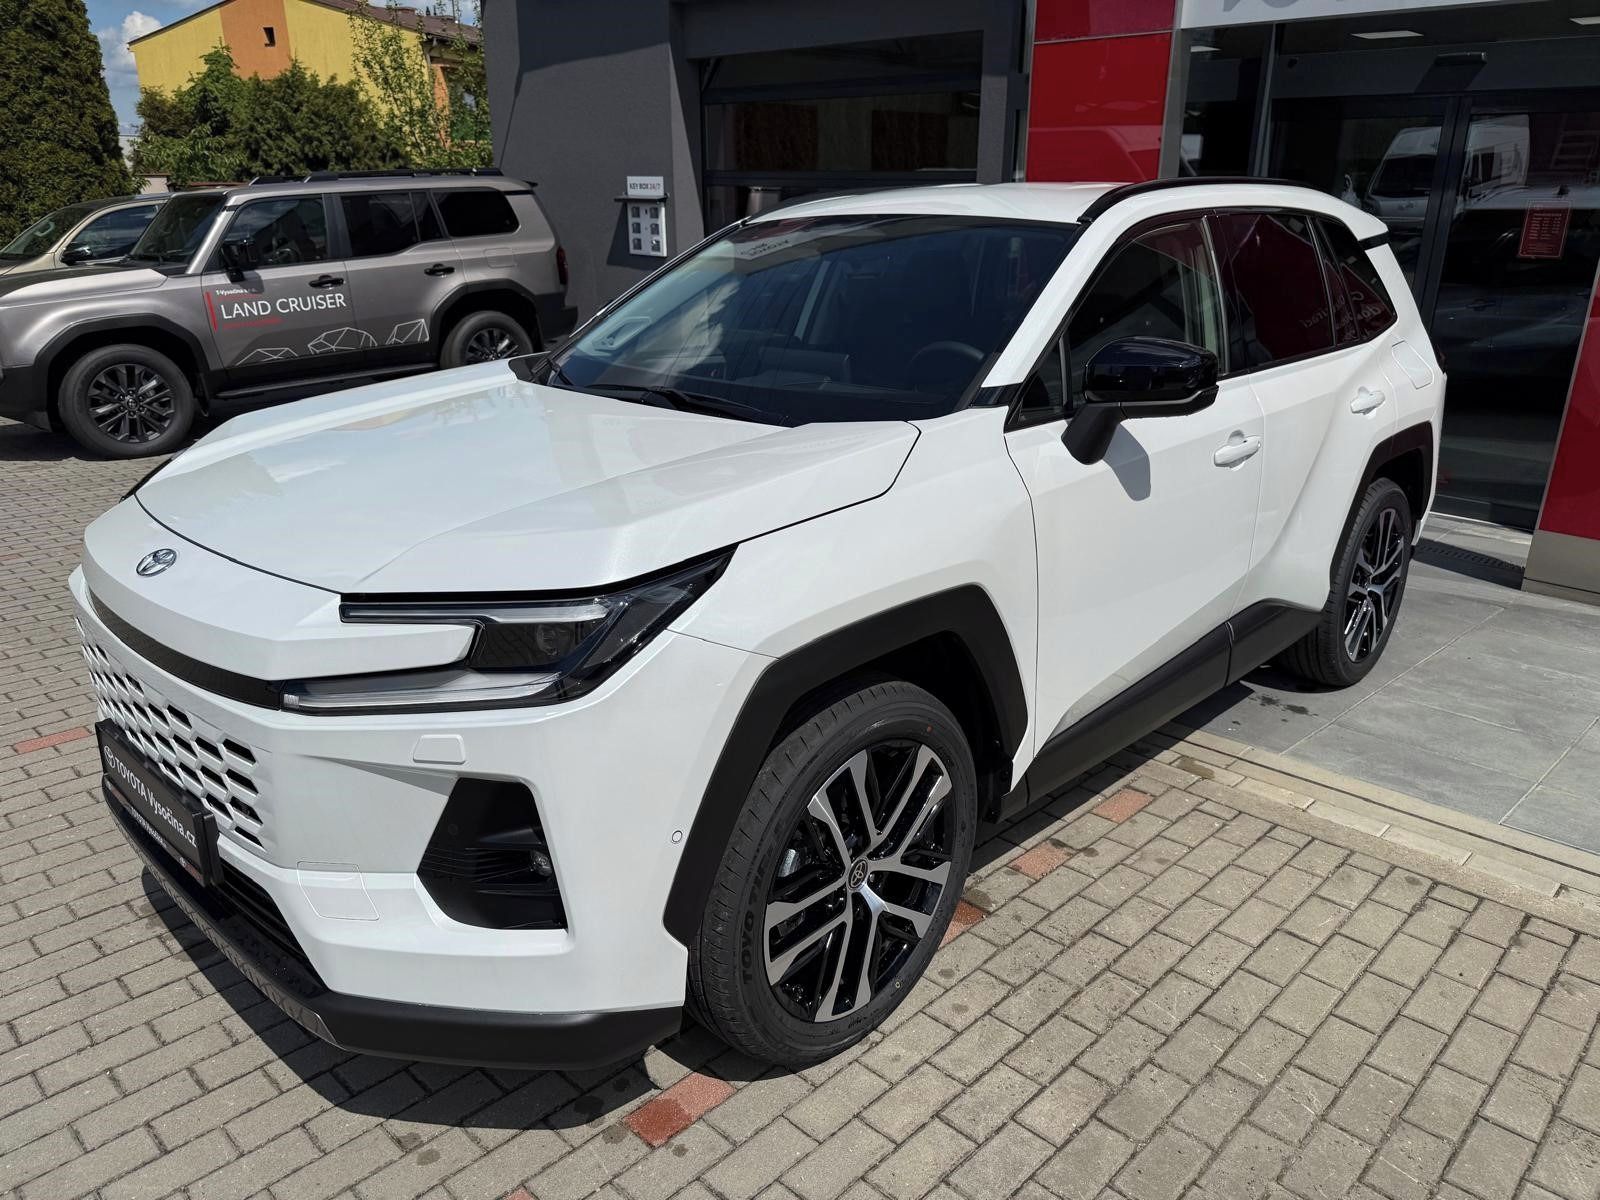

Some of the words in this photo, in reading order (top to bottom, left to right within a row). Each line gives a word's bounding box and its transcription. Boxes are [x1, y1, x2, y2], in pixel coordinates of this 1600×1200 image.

[220, 300, 271, 319] LAND
[276, 293, 347, 313] CRUISER
[114, 756, 149, 802] TOYOTA
[147, 787, 197, 848] Vysočina.cz
[741, 910, 754, 984] TOYO
